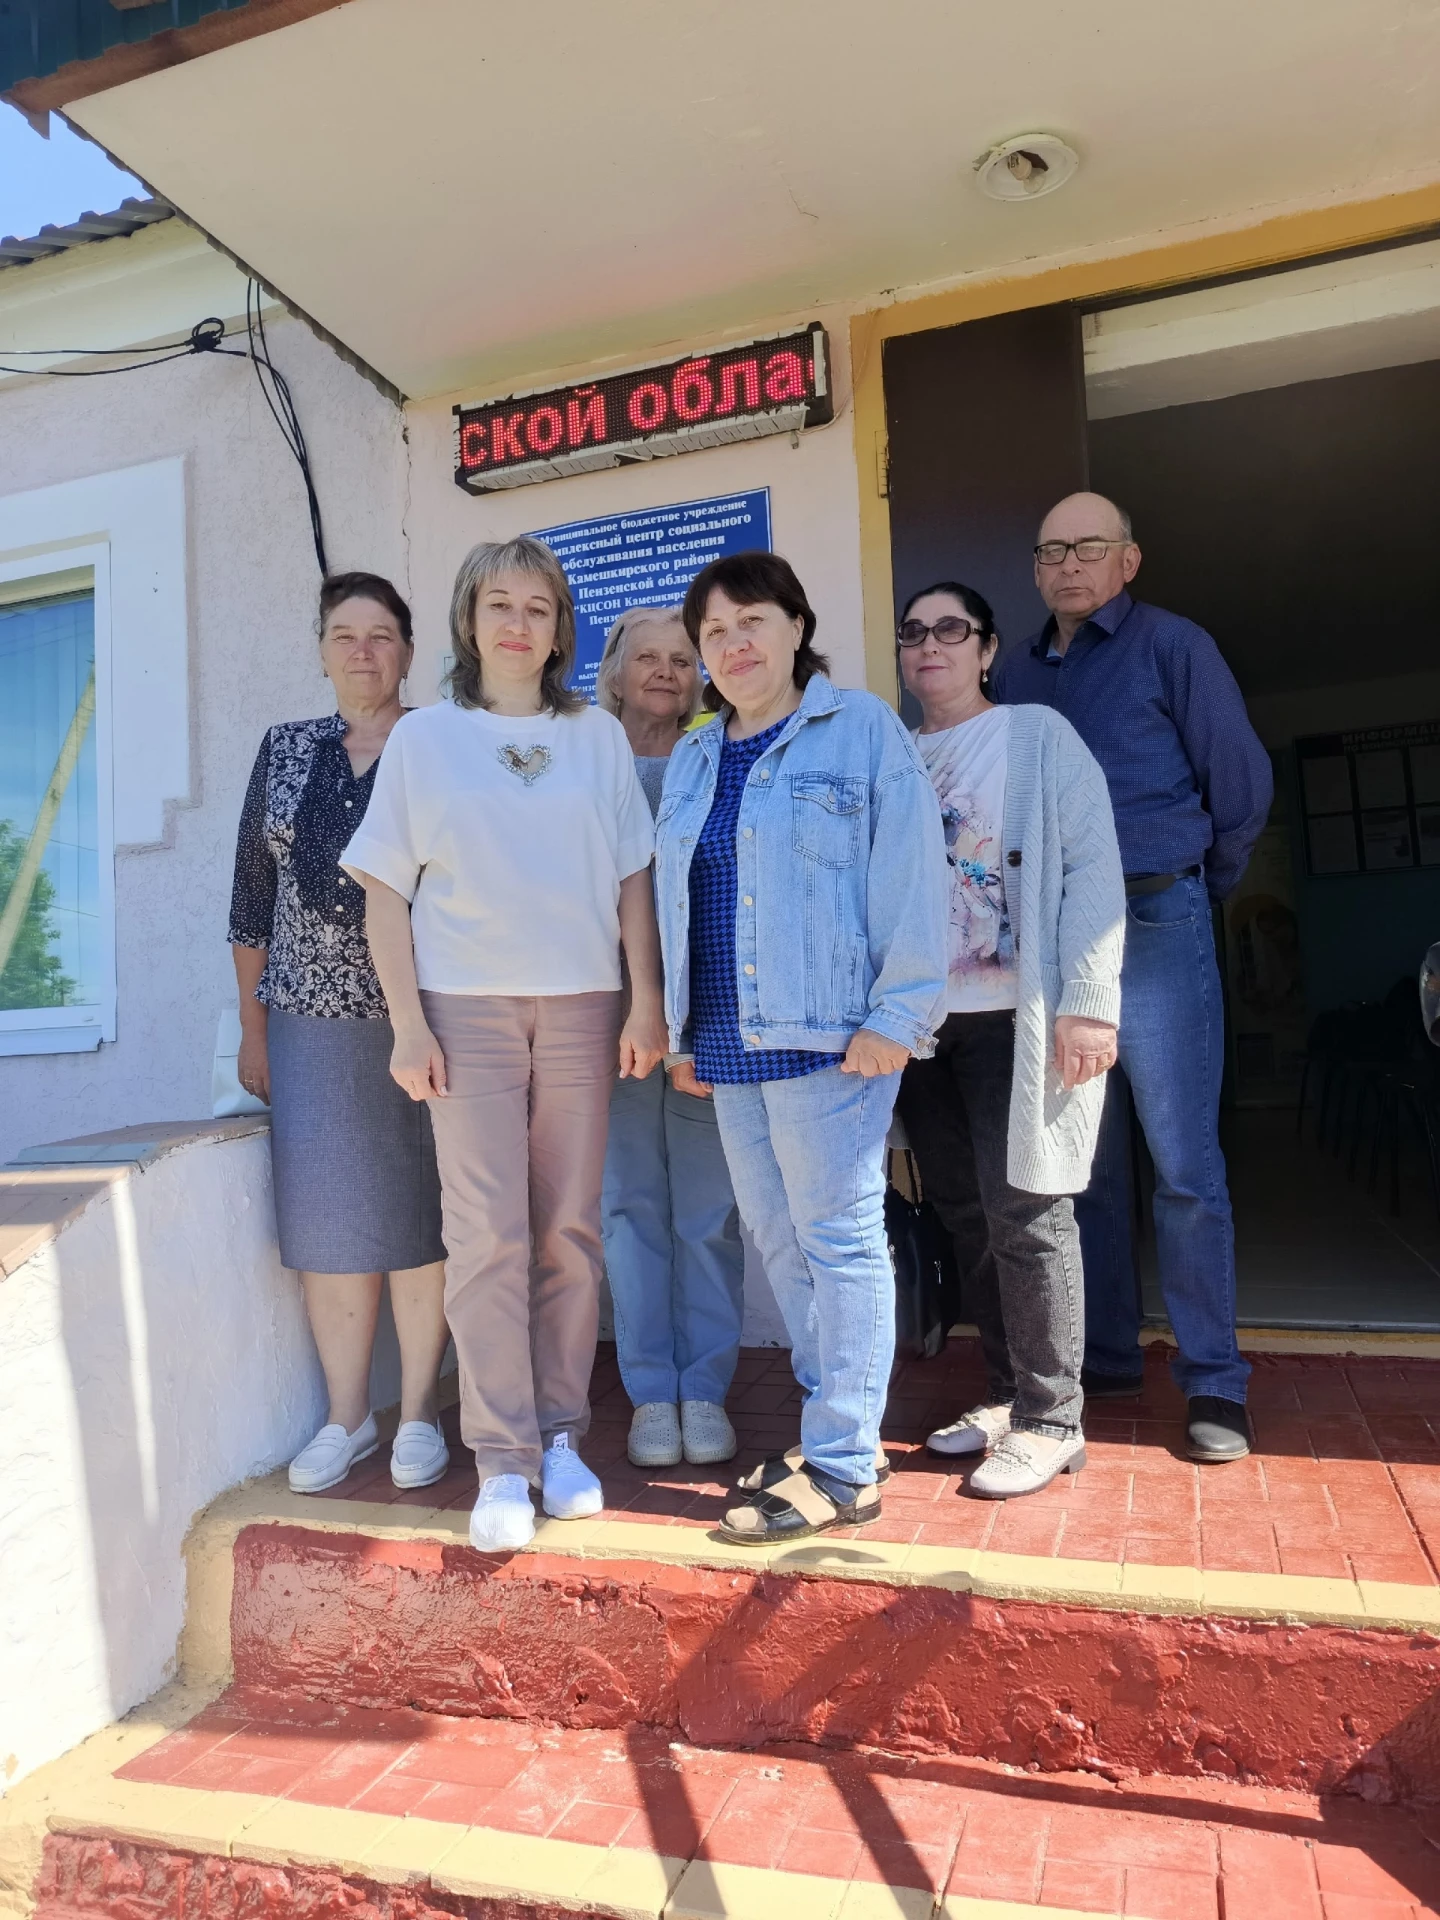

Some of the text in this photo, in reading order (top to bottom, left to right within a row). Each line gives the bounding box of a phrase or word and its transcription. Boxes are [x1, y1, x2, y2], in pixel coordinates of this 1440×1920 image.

[461, 350, 814, 467] ской обла
[541, 500, 747, 545] Муниципальное бюджетное учреждение
[553, 514, 752, 557] мплексный центр социального
[562, 535, 725, 571] обслуживания населения
[568, 552, 720, 586] Камешкирского района
[578, 572, 699, 600] Пензенской облас
[624, 590, 689, 607] Камешкирс
[589, 612, 624, 626] Пензе
